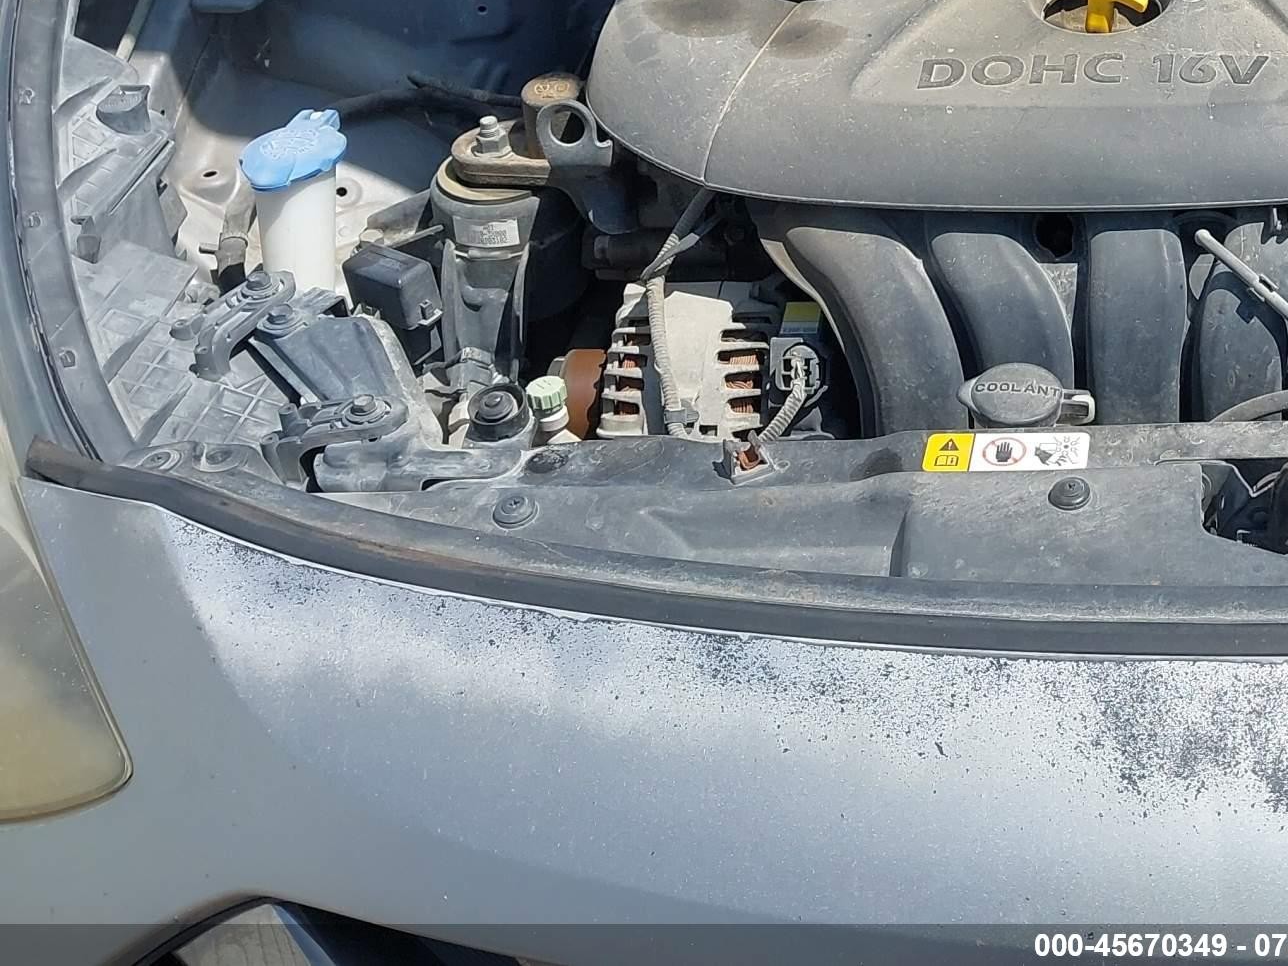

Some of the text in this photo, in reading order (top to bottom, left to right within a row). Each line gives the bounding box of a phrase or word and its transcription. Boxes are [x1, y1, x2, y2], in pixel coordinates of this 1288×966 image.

[916, 52, 1270, 89] DOHC 16V
[975, 382, 1061, 398] COOLANT
